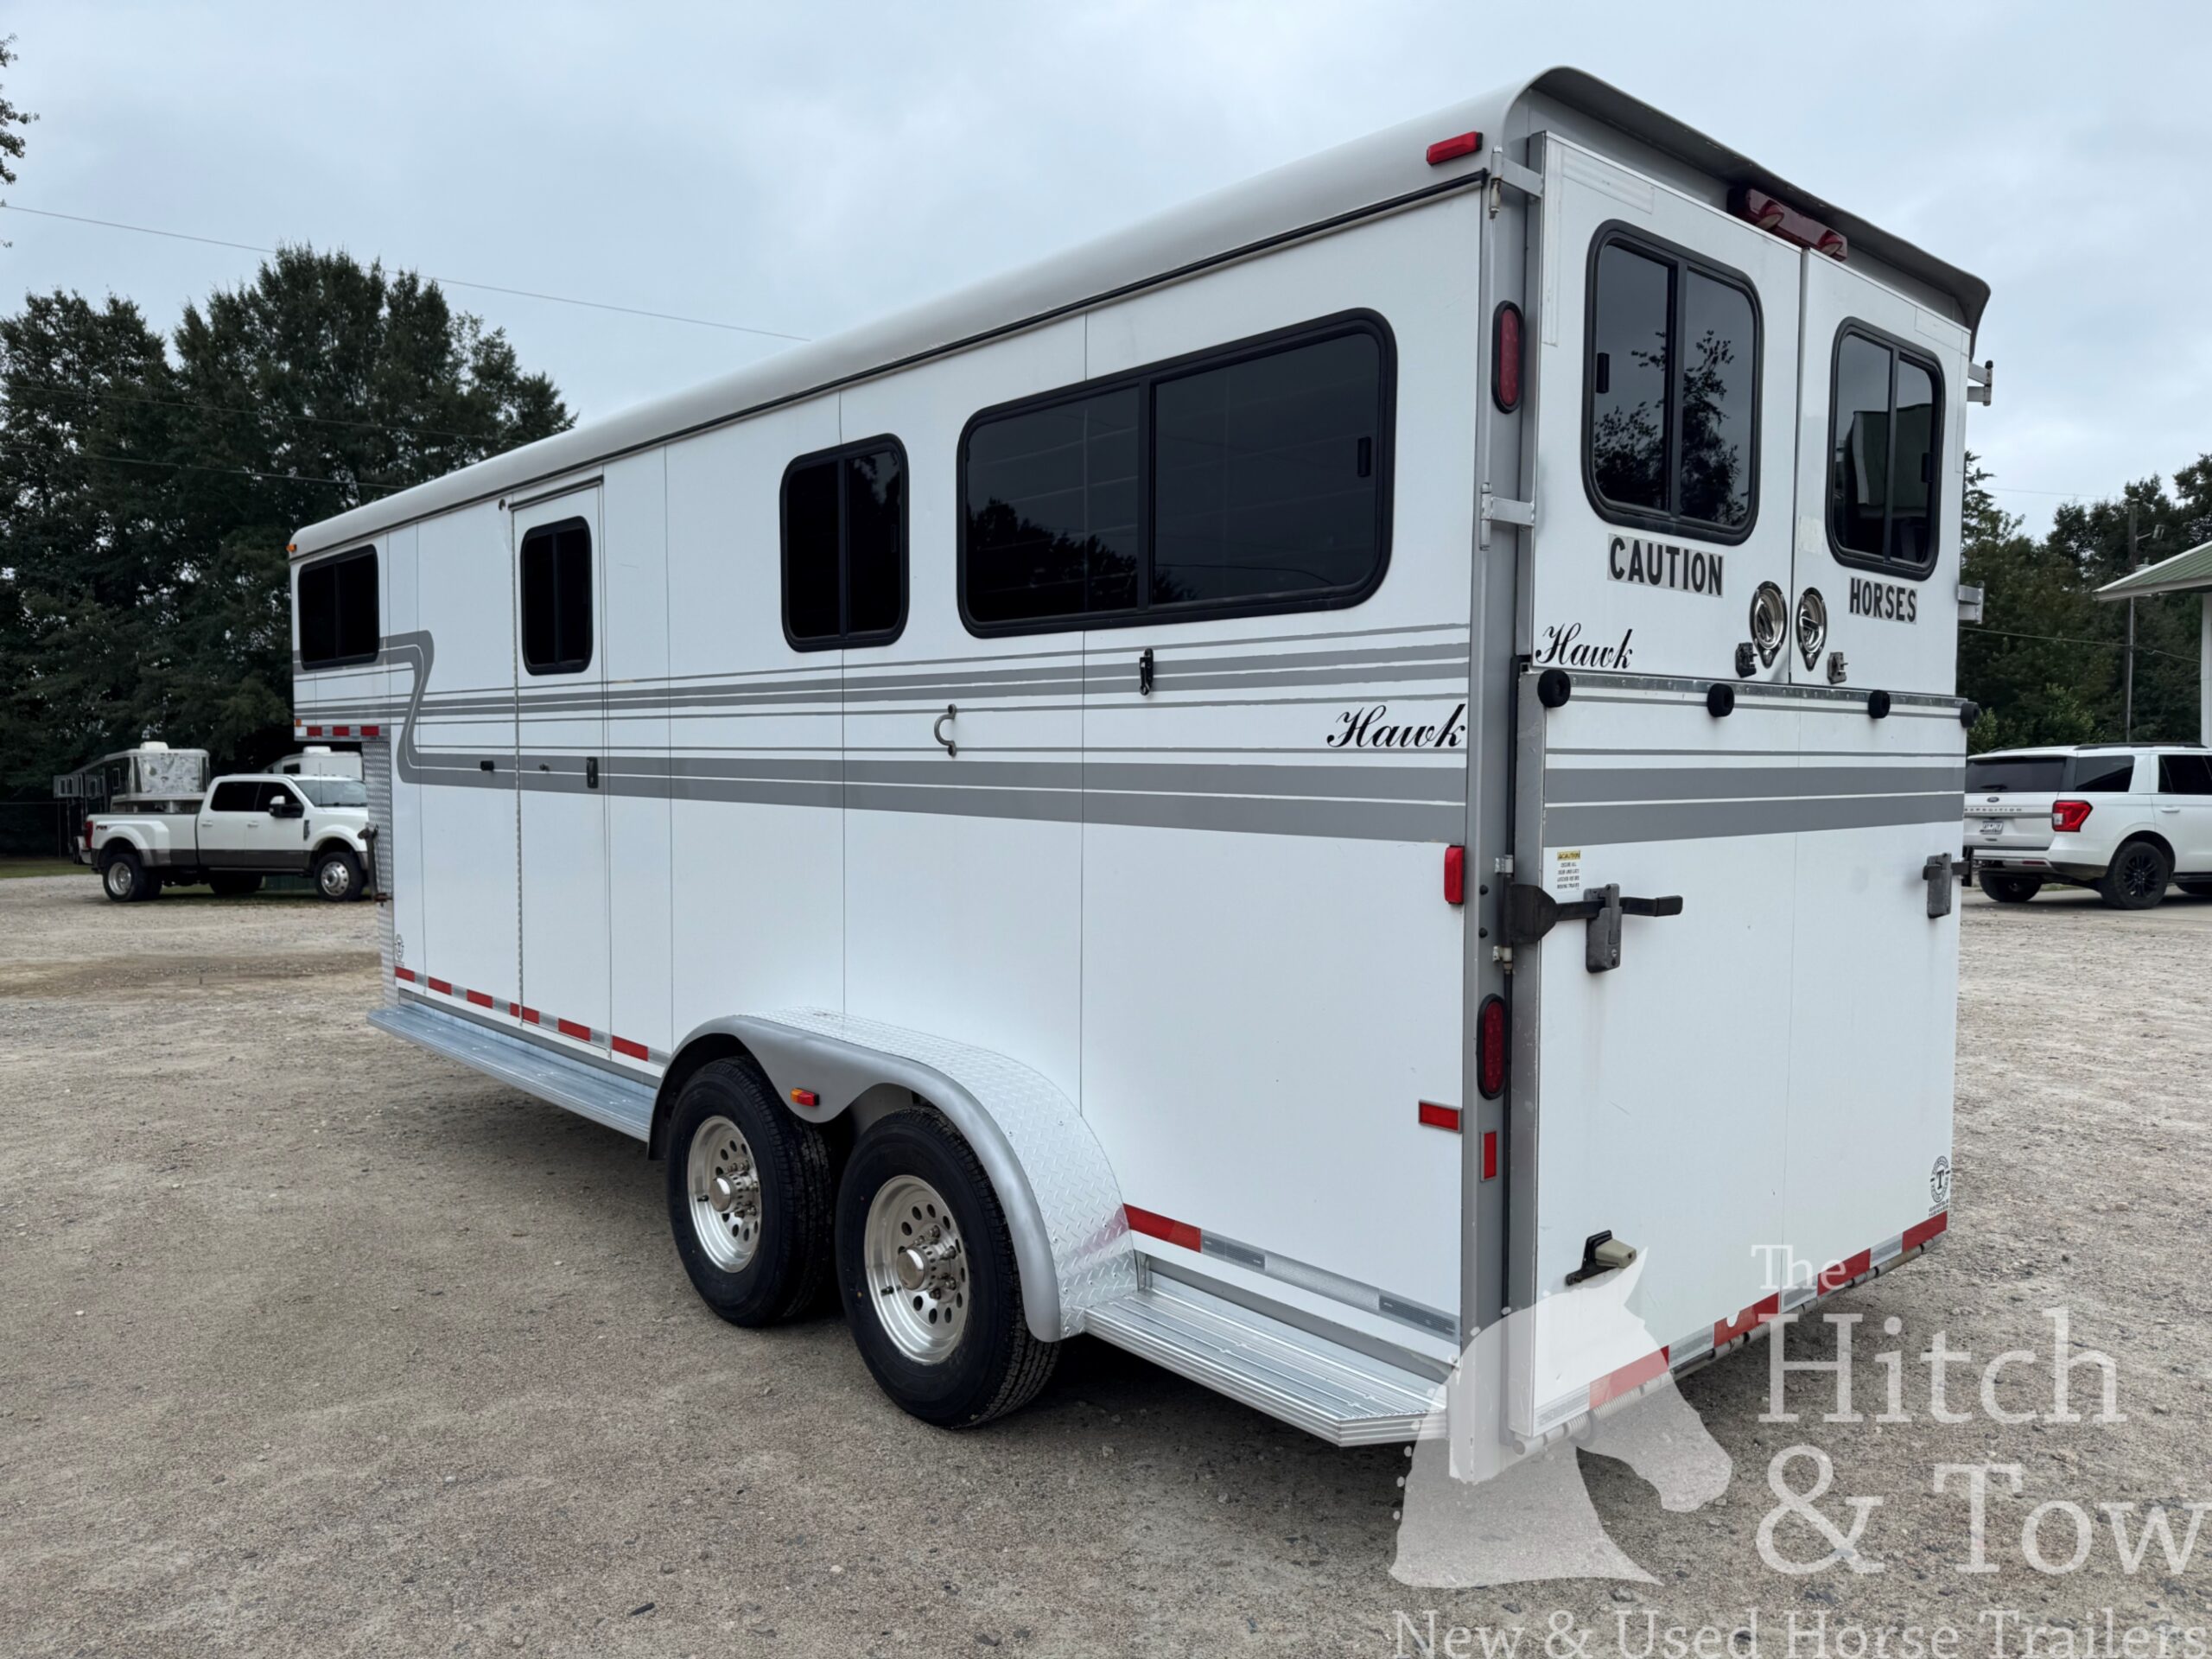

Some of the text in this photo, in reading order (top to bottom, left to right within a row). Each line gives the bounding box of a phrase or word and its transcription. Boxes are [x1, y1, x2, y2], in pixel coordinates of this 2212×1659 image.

[1610, 537, 1723, 596] CAUTION
[1849, 577, 1916, 623] HORSES
[1535, 622, 1633, 670] Hawk
[1326, 702, 1466, 748] Hawk
